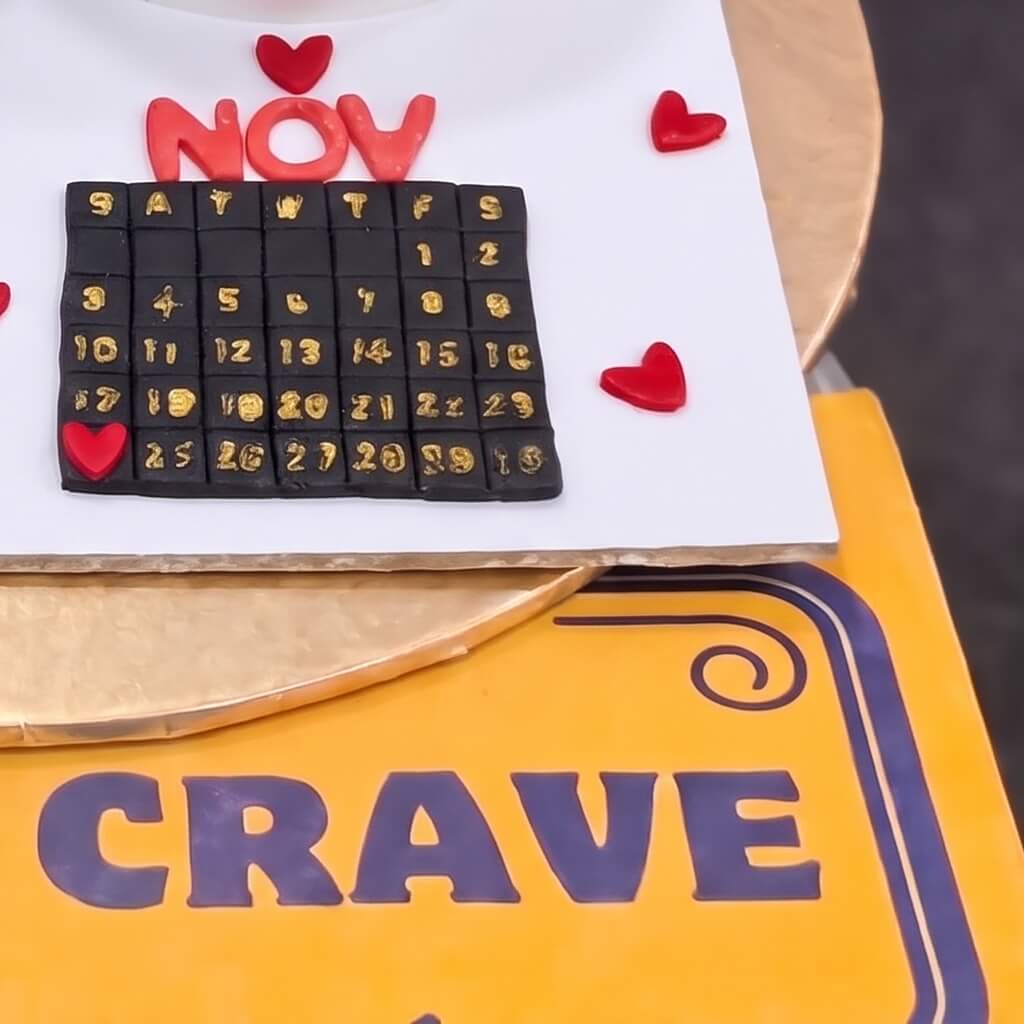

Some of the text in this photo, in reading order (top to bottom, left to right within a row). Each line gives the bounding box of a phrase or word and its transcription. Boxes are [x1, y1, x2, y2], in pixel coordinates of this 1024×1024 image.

[146, 94, 436, 182] NOV
[209, 188, 233, 216] T
[342, 191, 368, 220] T
[413, 193, 433, 221] F
[479, 194, 503, 221] S
[416, 240, 500, 267] 1 2
[218, 287, 241, 313] 5
[74, 335, 118, 364] 10
[143, 337, 177, 365] 11
[214, 336, 253, 364] 12
[279, 337, 321, 366] 13
[352, 337, 393, 365] 14
[416, 339, 460, 368] 15
[276, 390, 329, 420] 20
[351, 393, 395, 421] 21
[144, 440, 194, 469] 25
[285, 439, 337, 472] 27
[37, 771, 822, 910] CRAVE
